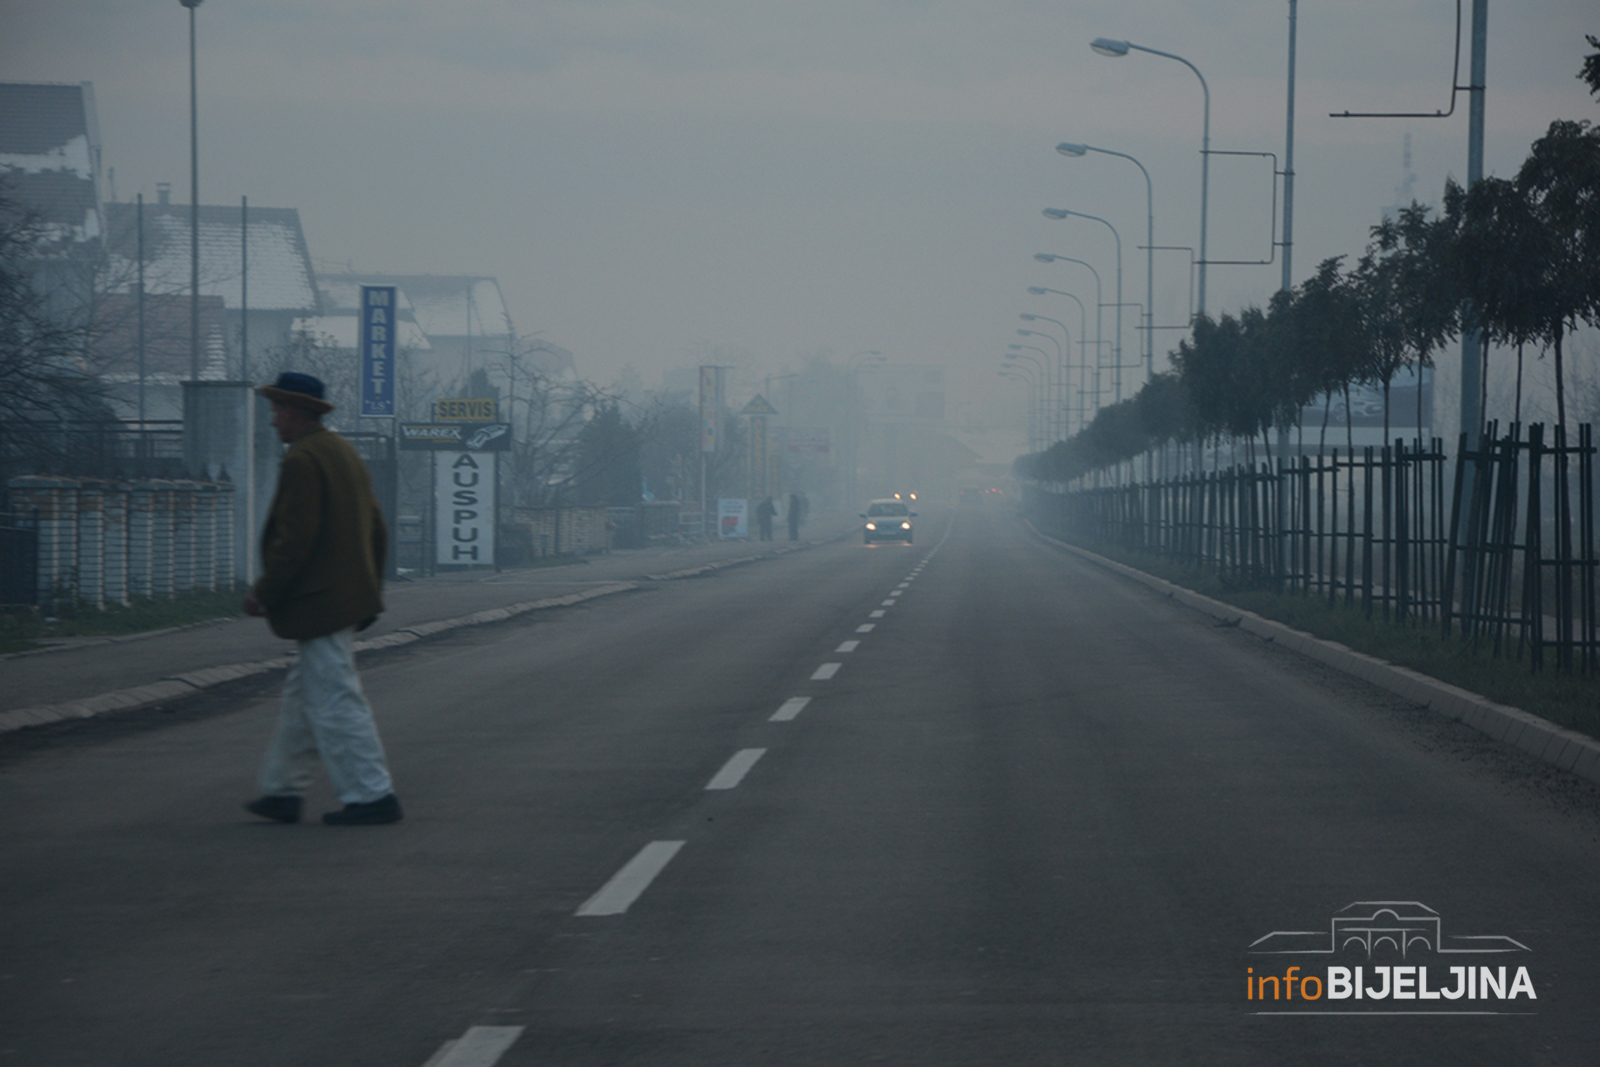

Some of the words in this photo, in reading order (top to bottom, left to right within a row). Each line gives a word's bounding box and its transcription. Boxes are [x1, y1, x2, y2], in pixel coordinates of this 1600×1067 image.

[368, 290, 389, 394] MARKET
[402, 425, 463, 440] WAREX
[439, 400, 492, 419] SERVIS
[452, 453, 479, 561] AUSPUH
